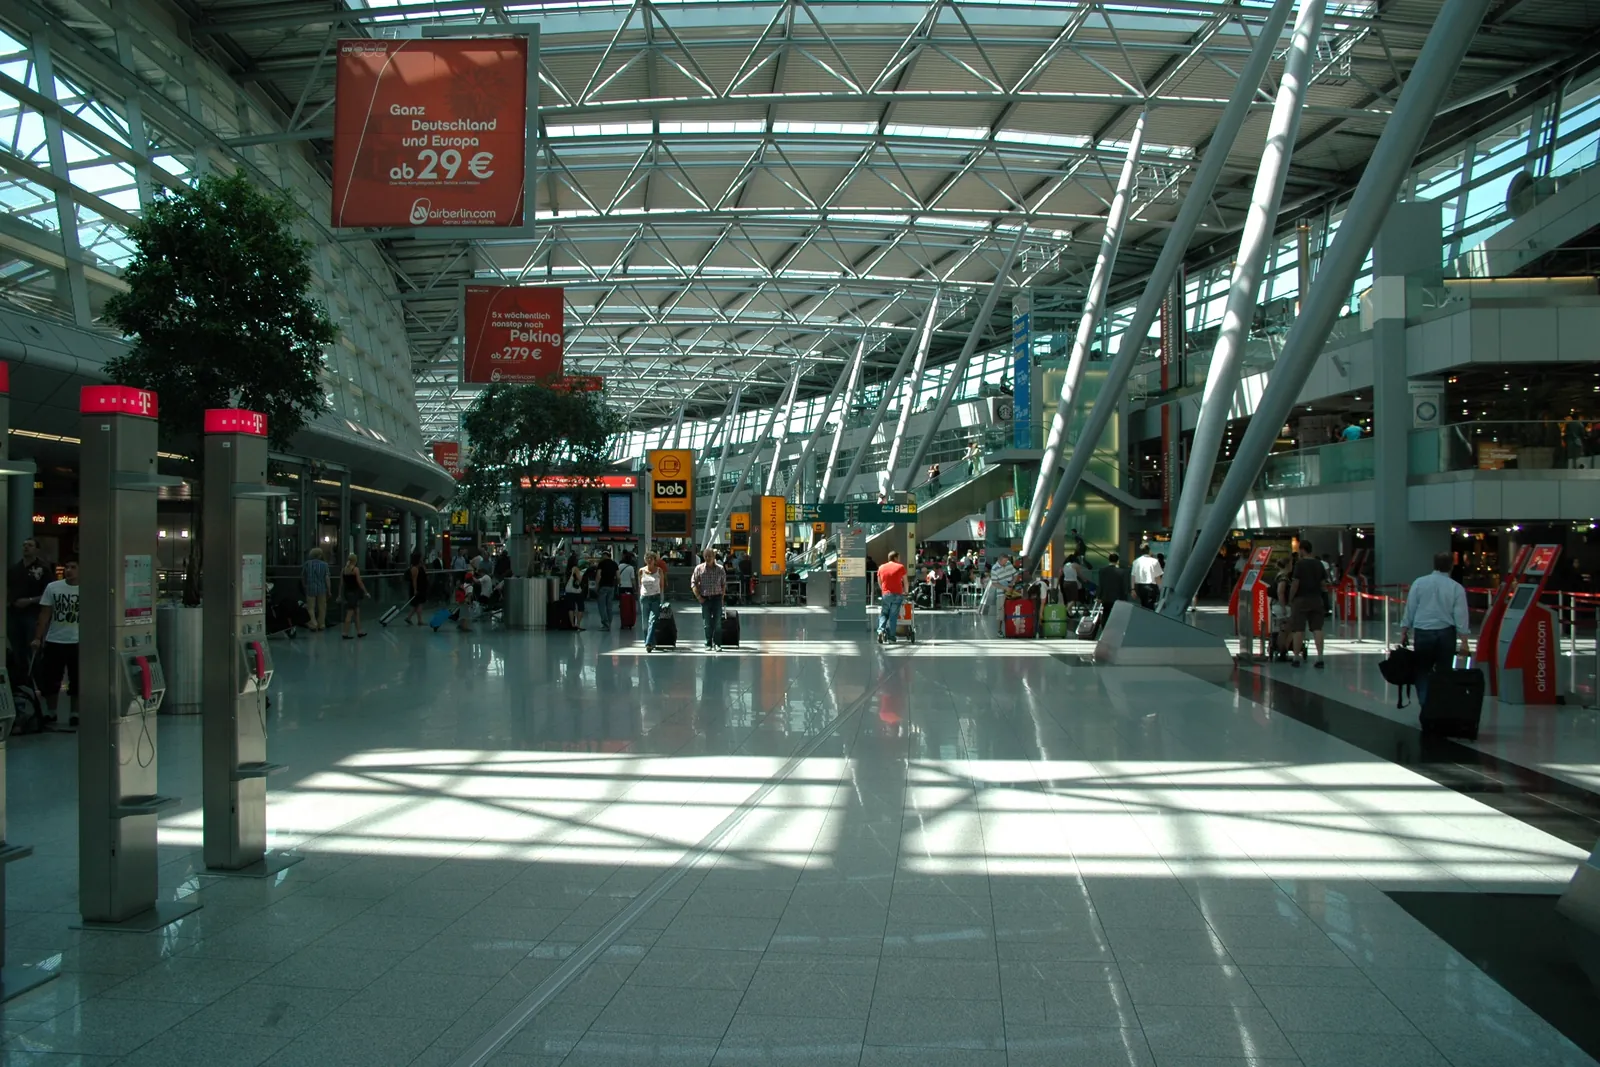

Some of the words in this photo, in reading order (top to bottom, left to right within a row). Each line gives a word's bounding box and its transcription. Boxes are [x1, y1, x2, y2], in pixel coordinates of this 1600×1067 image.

[389, 104, 425, 116] Ganz
[411, 118, 497, 131] Deutschland
[402, 135, 428, 147] und
[432, 135, 479, 150] Europa
[389, 163, 415, 180] ab
[417, 149, 462, 180] 29
[468, 151, 495, 179] €
[429, 208, 496, 219] airberlin.com
[504, 312, 551, 320] wöchentlich
[491, 321, 523, 329] nonstop
[510, 329, 561, 347] Peking
[503, 346, 530, 360] 279
[531, 348, 542, 360] €
[894, 505, 900, 513] B
[57, 515, 68, 525] gold
[770, 500, 778, 564] Handelsblatt
[1536, 620, 1546, 692] airberlin.com
